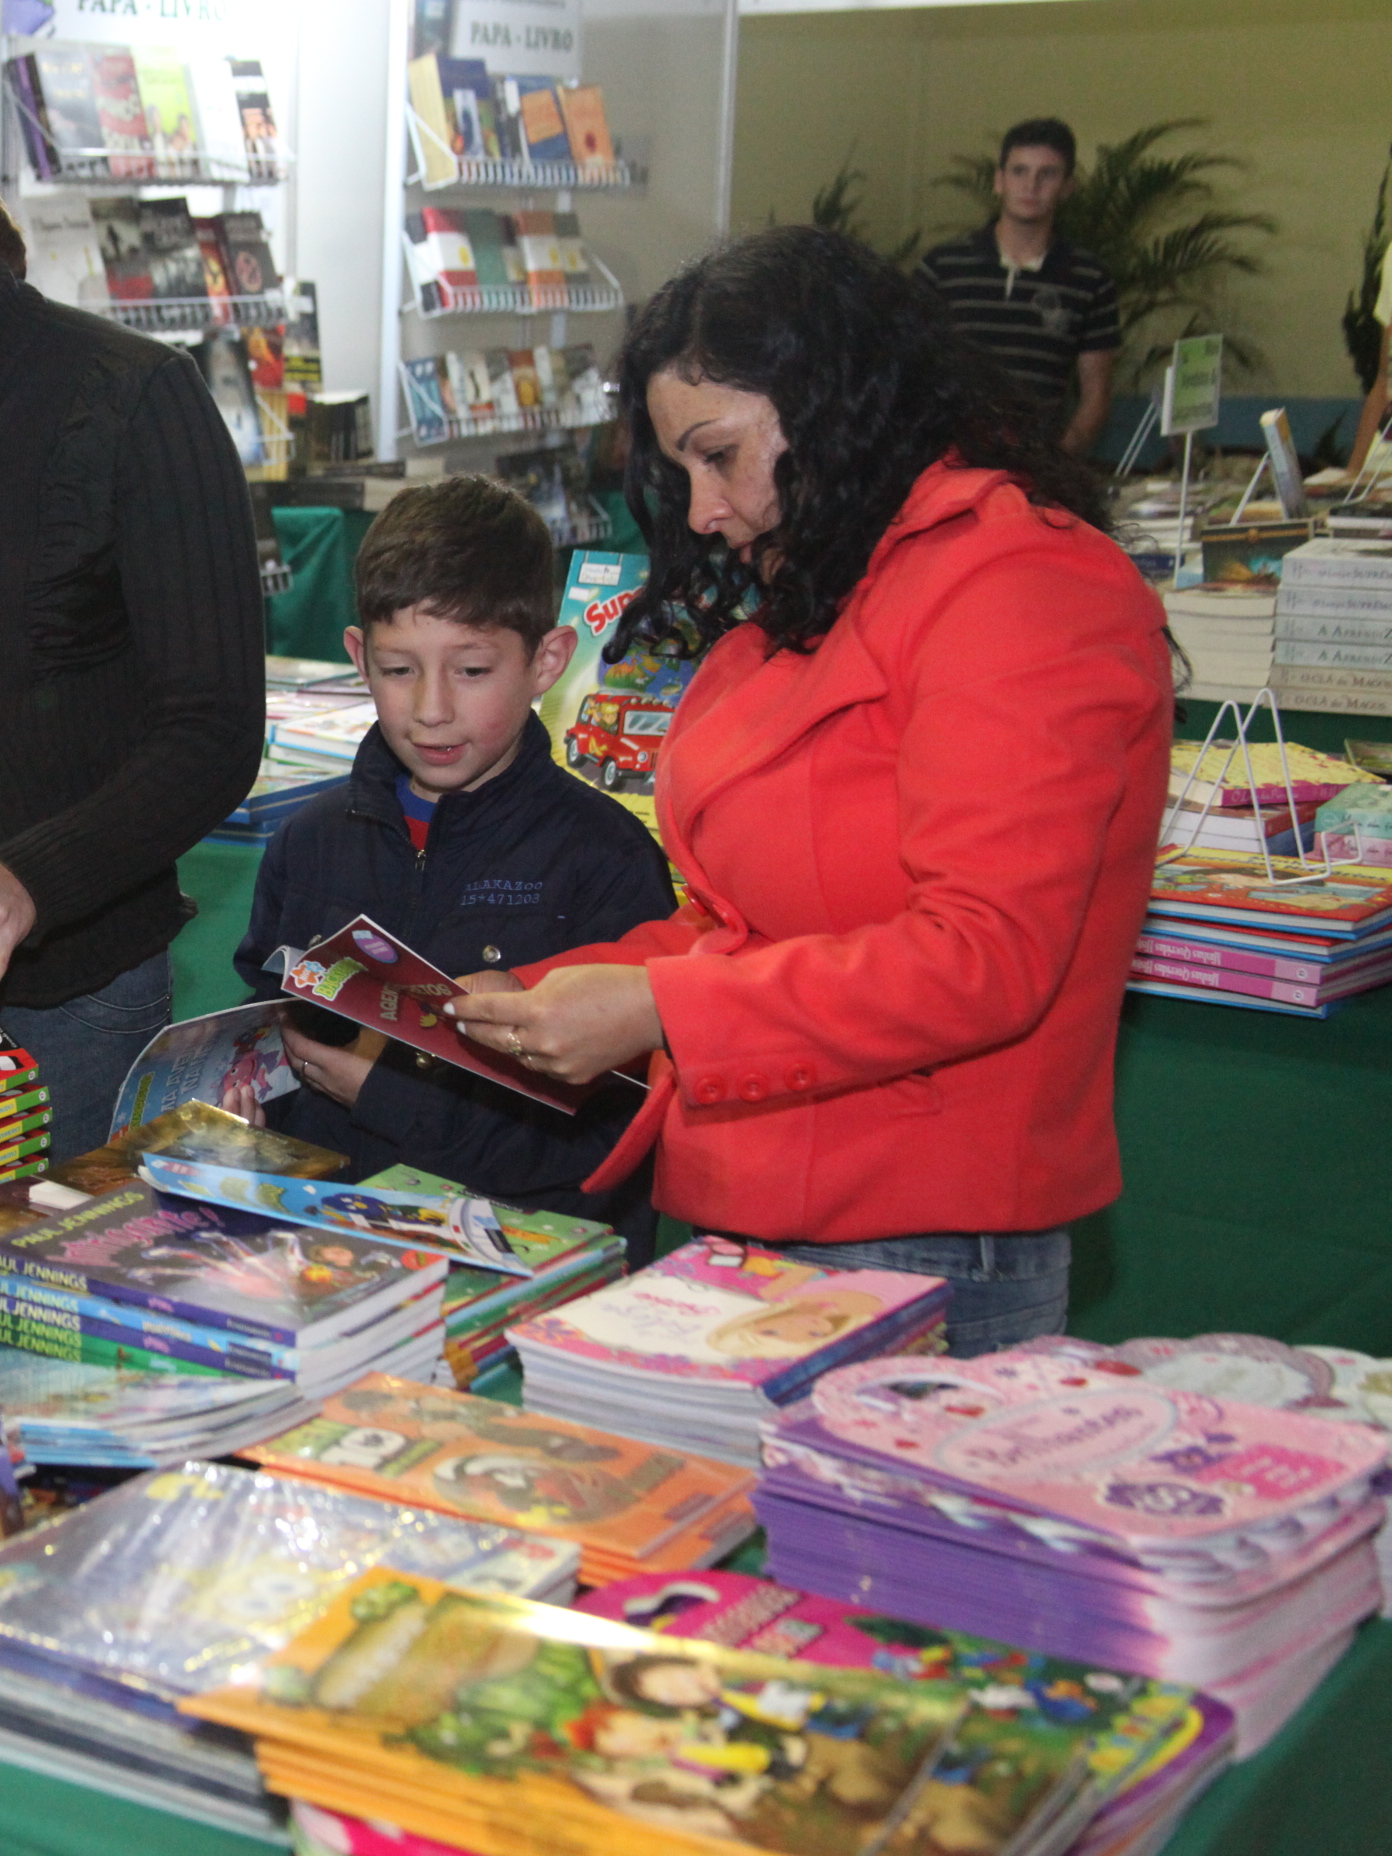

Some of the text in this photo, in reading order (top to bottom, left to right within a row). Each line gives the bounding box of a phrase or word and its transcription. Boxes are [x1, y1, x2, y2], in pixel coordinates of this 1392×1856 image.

[470, 21, 512, 47] PAPA
[525, 25, 574, 50] LIVRO
[465, 879, 544, 892] ALAKAZOO
[10, 1227, 64, 1249] PAUL
[58, 1191, 146, 1232] JENNINGS
[22, 1258, 89, 1292] JENNINGS
[15, 1284, 80, 1313] JENNINGS
[13, 1300, 82, 1331] JENNINGS
[15, 1316, 83, 1348] JENNINGS
[16, 1331, 83, 1364] JENNINGS
